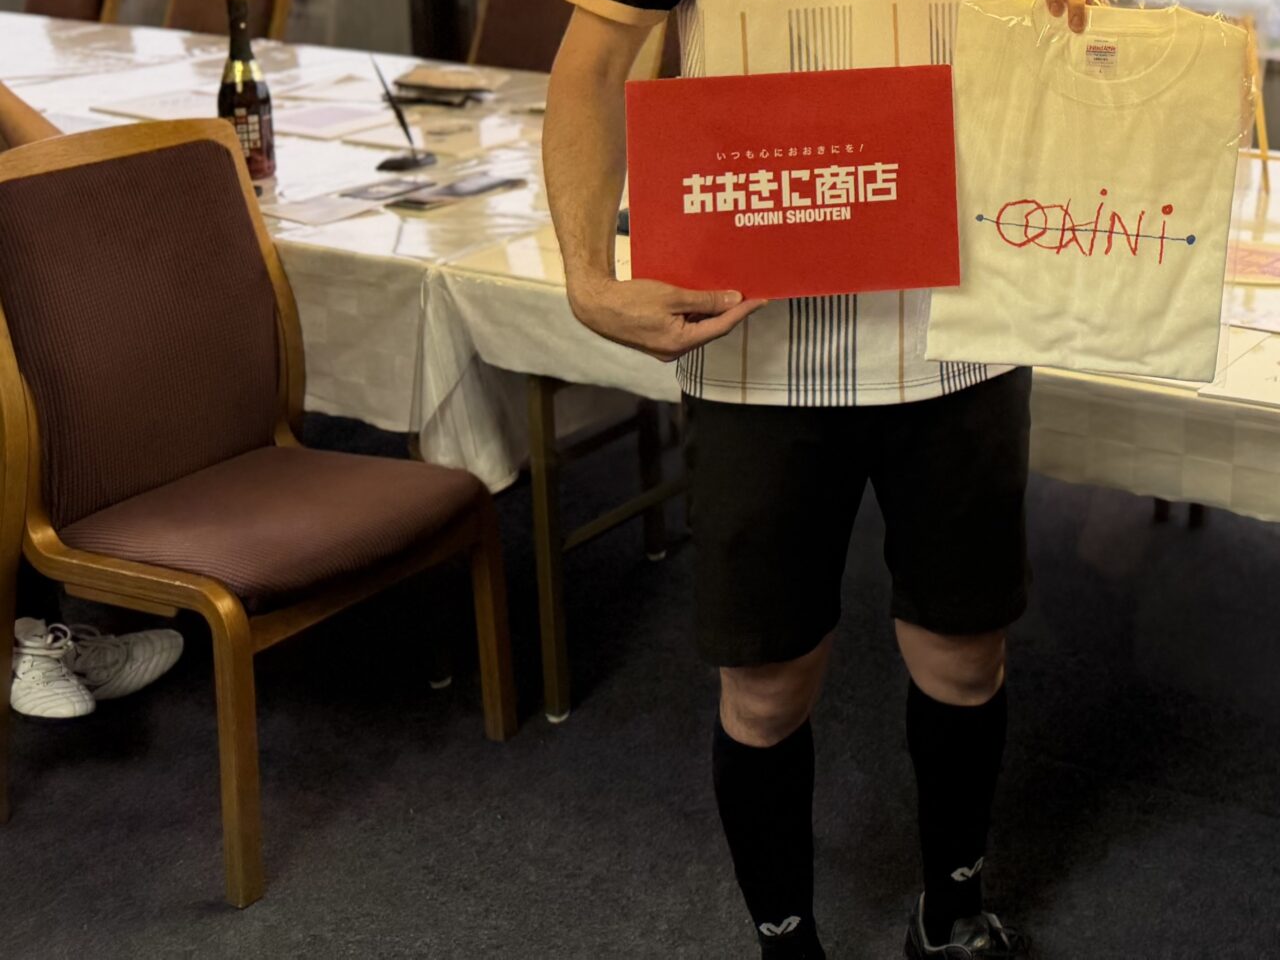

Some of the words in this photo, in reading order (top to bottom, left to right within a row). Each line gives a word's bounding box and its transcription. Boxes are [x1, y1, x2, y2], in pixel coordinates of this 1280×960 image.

[716, 143, 864, 161] いつも心におおきにを!
[682, 162, 899, 214] おおきに商店
[735, 210, 783, 228] OOKINI
[786, 206, 851, 224] SHOUTEN
